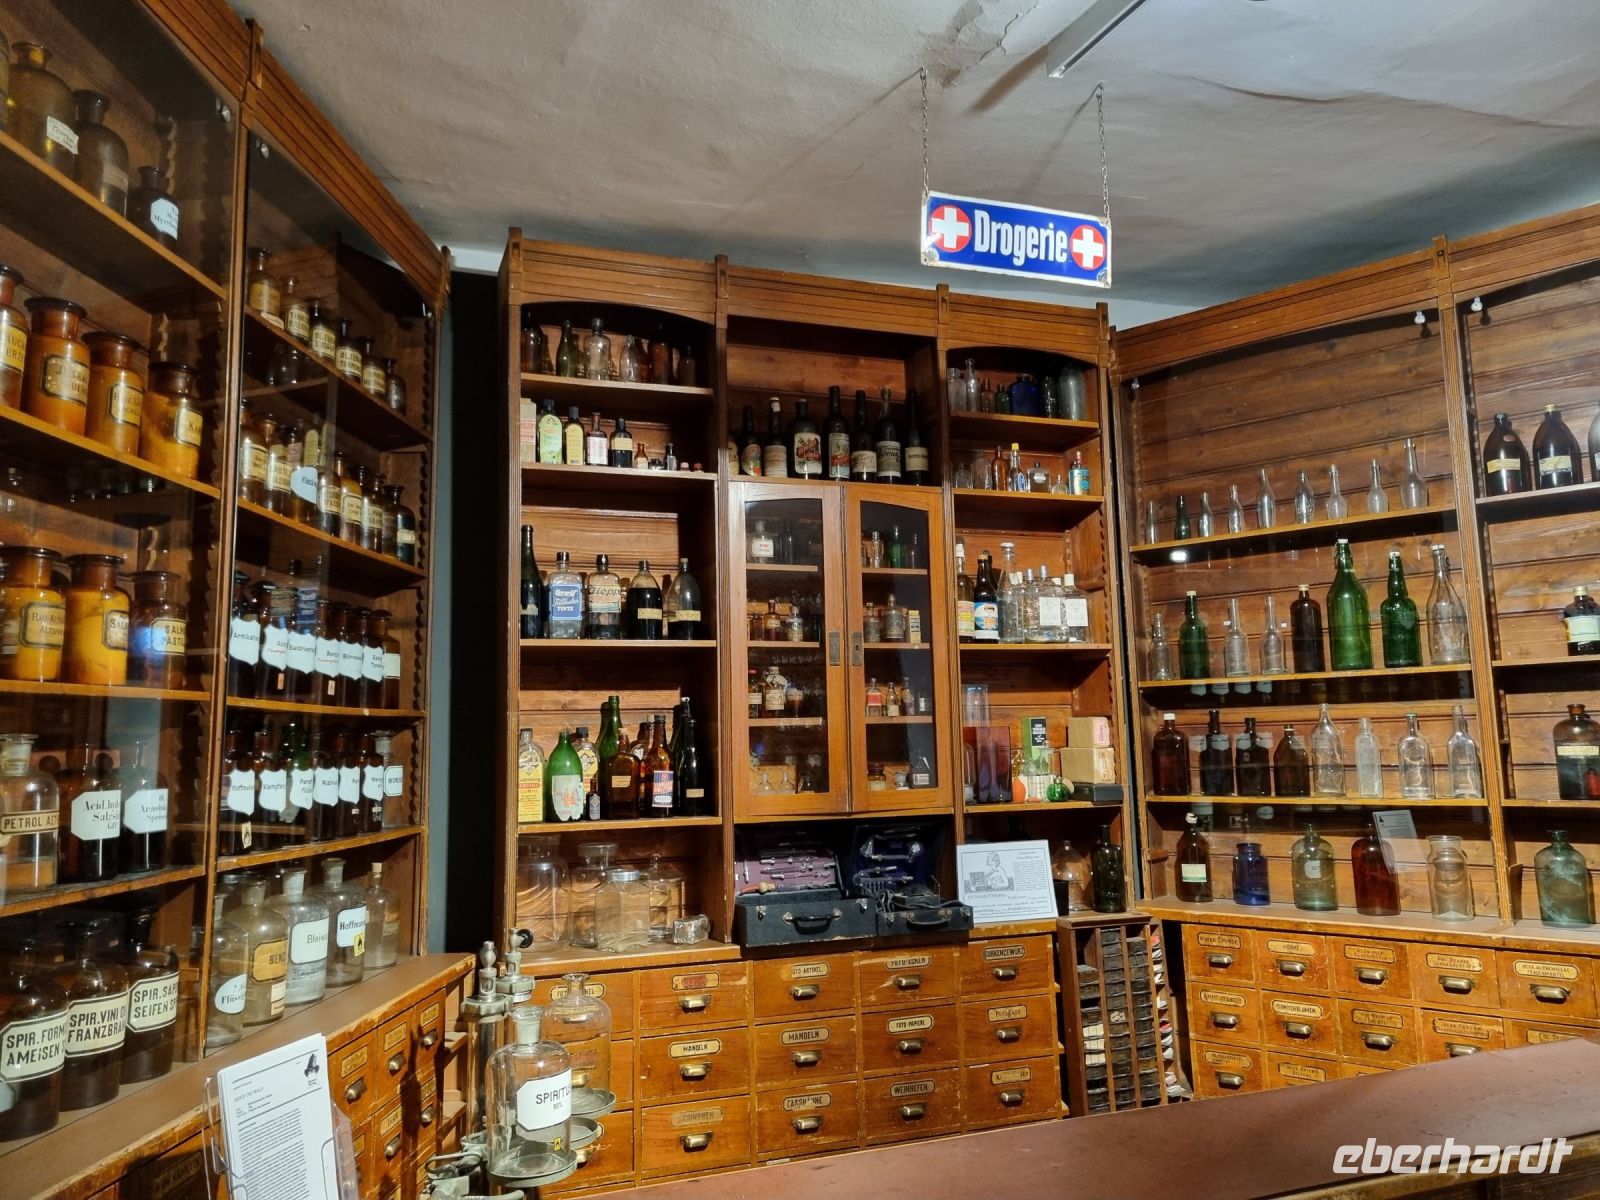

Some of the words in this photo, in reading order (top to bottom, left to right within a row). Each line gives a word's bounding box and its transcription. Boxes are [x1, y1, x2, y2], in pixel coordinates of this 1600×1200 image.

[974, 209, 1068, 266] Drogerie
[4, 816, 43, 829] PETROL
[134, 998, 169, 1019] SEIFEN
[788, 1030, 821, 1042] MANDELN
[536, 1084, 571, 1105] SPIRITU
[894, 1082, 929, 1095] WEINHEFEN
